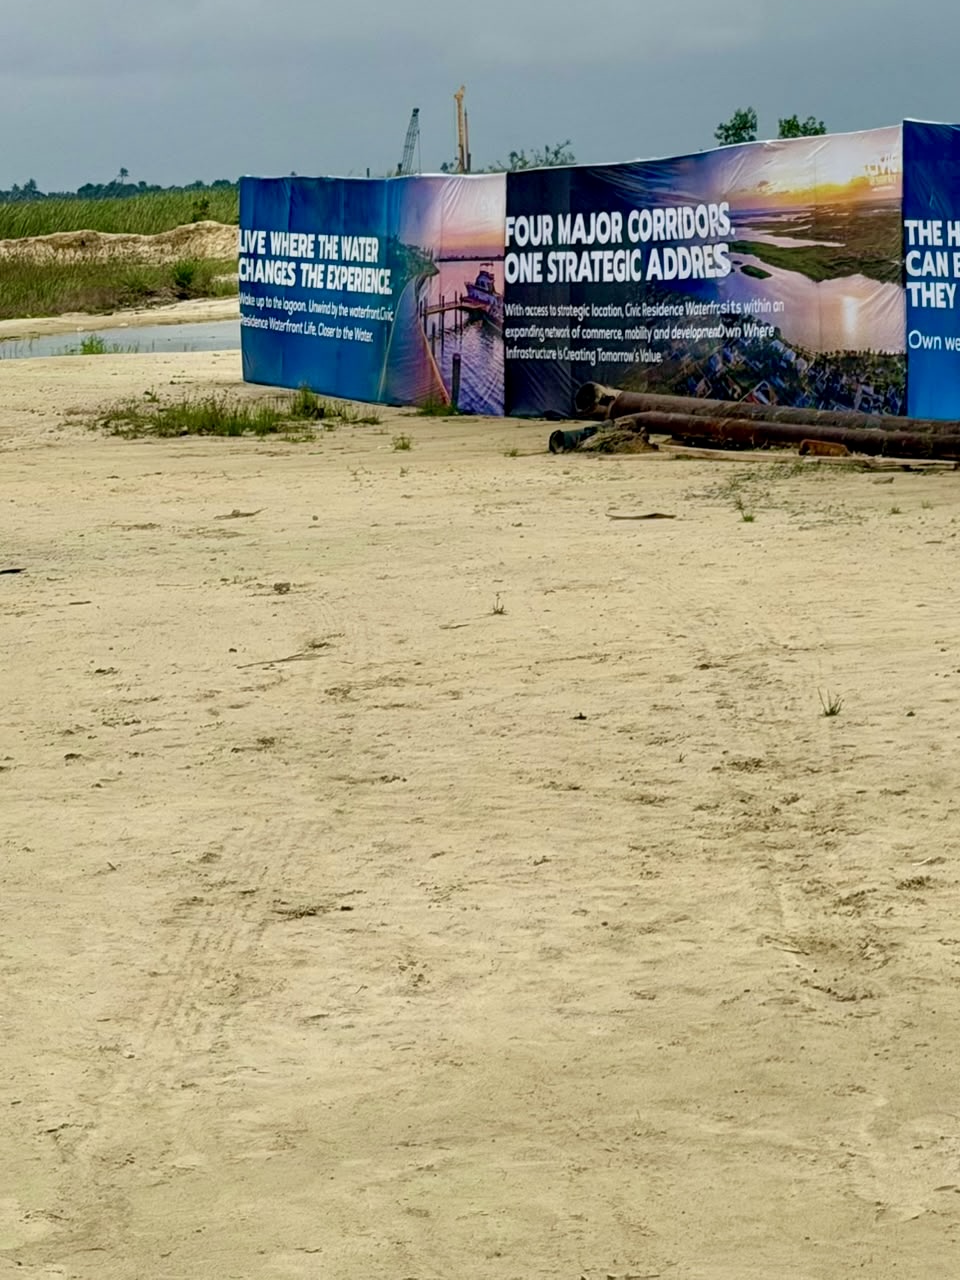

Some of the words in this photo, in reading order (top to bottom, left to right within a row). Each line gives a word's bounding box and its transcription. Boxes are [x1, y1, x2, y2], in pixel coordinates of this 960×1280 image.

[504, 214, 554, 247] FOUR
[557, 211, 622, 245] MAJOR
[627, 201, 736, 243] CORRIDORS.
[903, 219, 944, 247] THE
[238, 228, 267, 255] LIVE
[269, 230, 316, 259] WHERE
[317, 233, 340, 261] THE
[340, 235, 379, 264] WATER
[238, 256, 297, 287] CHANGES
[300, 262, 326, 289] THE
[325, 263, 394, 296] EXPERIENCE.
[503, 251, 544, 284] ONE
[546, 248, 642, 284] STRATEGIC
[904, 249, 949, 278] CAN
[256, 296, 265, 311] up
[265, 295, 273, 309] to
[273, 295, 283, 310] the
[308, 298, 332, 317] Unwind
[331, 300, 339, 320] by
[338, 302, 349, 318] the
[504, 302, 525, 317] With
[524, 305, 549, 317] access
[549, 303, 557, 317] to
[557, 301, 591, 322] strategic
[591, 301, 625, 319] location,
[624, 301, 642, 318] Civic
[641, 300, 685, 318] Residence
[720, 299, 742, 315] sits
[743, 297, 772, 315] within
[772, 300, 785, 313] an
[905, 281, 957, 310] THEY
[268, 316, 303, 335] Waterfront
[335, 325, 343, 339] to
[342, 325, 354, 340] the
[504, 323, 546, 343] expanding
[571, 324, 582, 339] of
[581, 327, 624, 342] commerce,
[653, 324, 671, 340] and
[742, 322, 775, 338] Where
[907, 329, 943, 351] Own
[505, 345, 557, 360] Infrastructure
[563, 345, 597, 367] Creating
[596, 347, 640, 363] Tomorrow's
